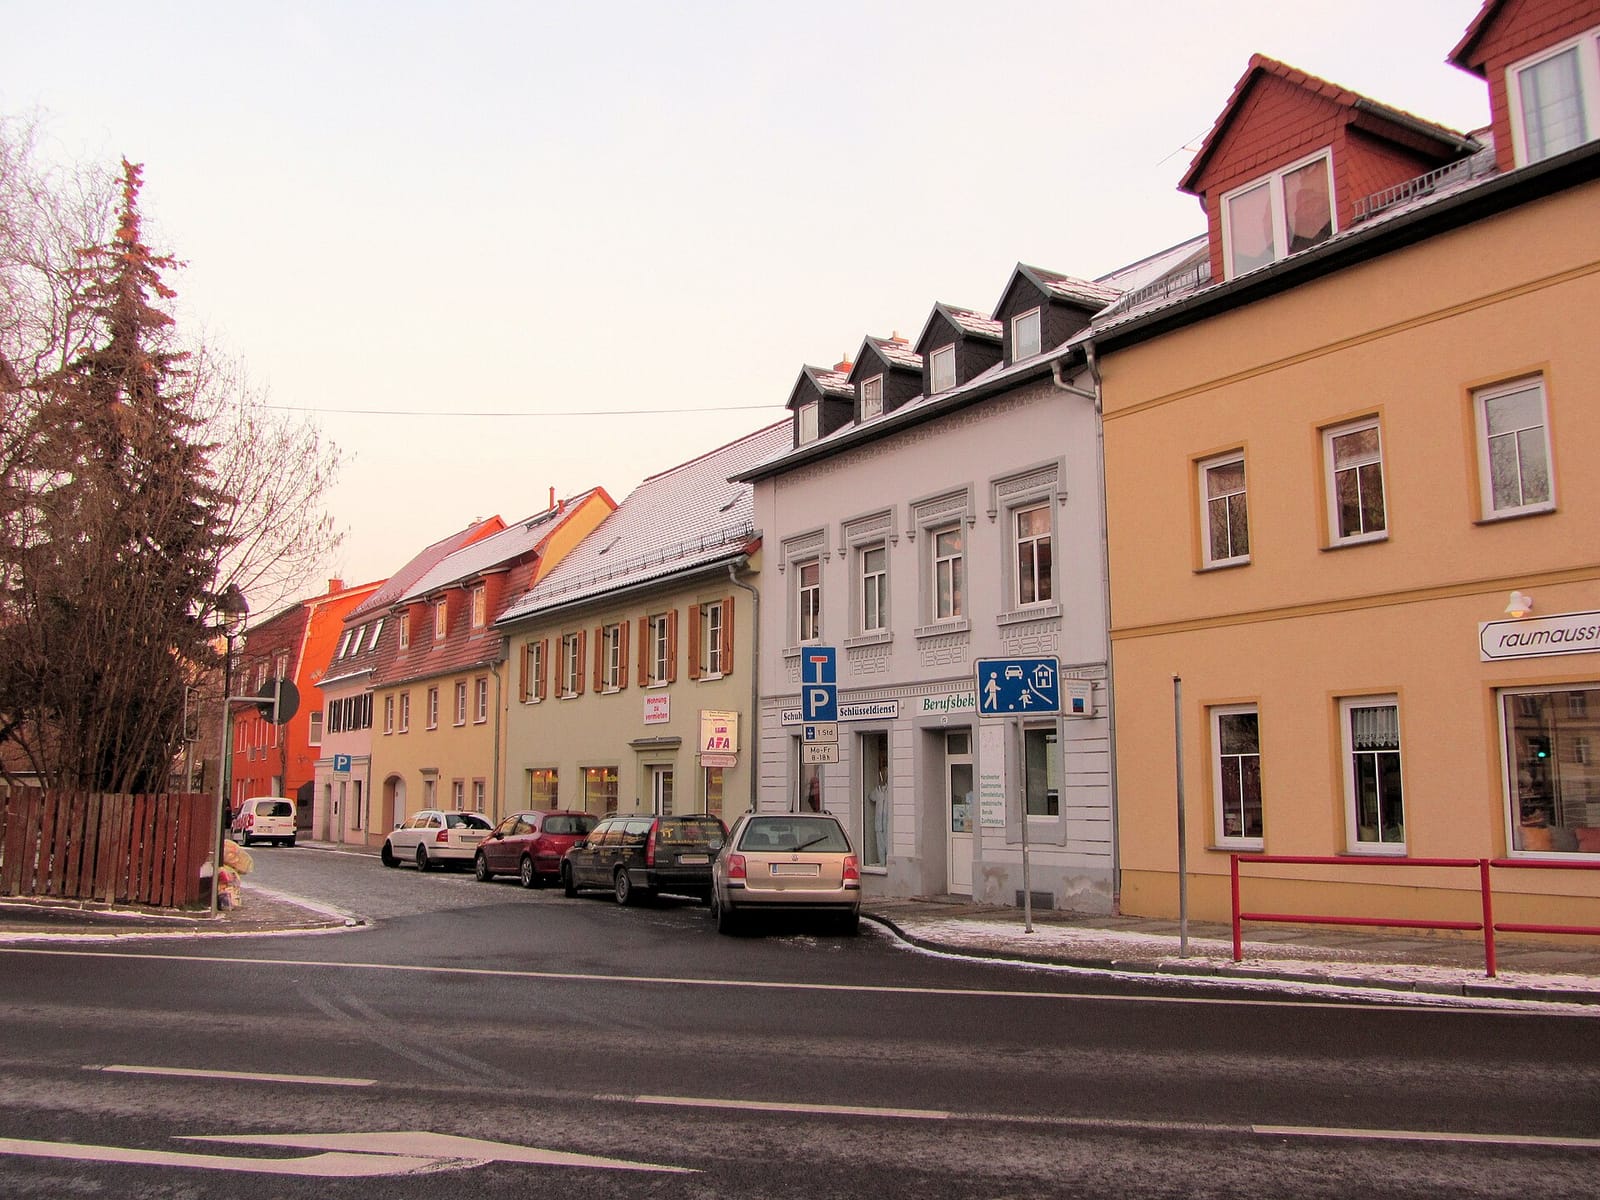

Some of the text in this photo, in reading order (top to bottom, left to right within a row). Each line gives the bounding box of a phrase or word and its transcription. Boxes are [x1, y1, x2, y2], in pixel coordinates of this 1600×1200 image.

[810, 689, 829, 718] P
[923, 693, 974, 713] Berufsbek
[783, 705, 895, 721] Schuh Schlüsseldienst
[337, 756, 348, 770] P
